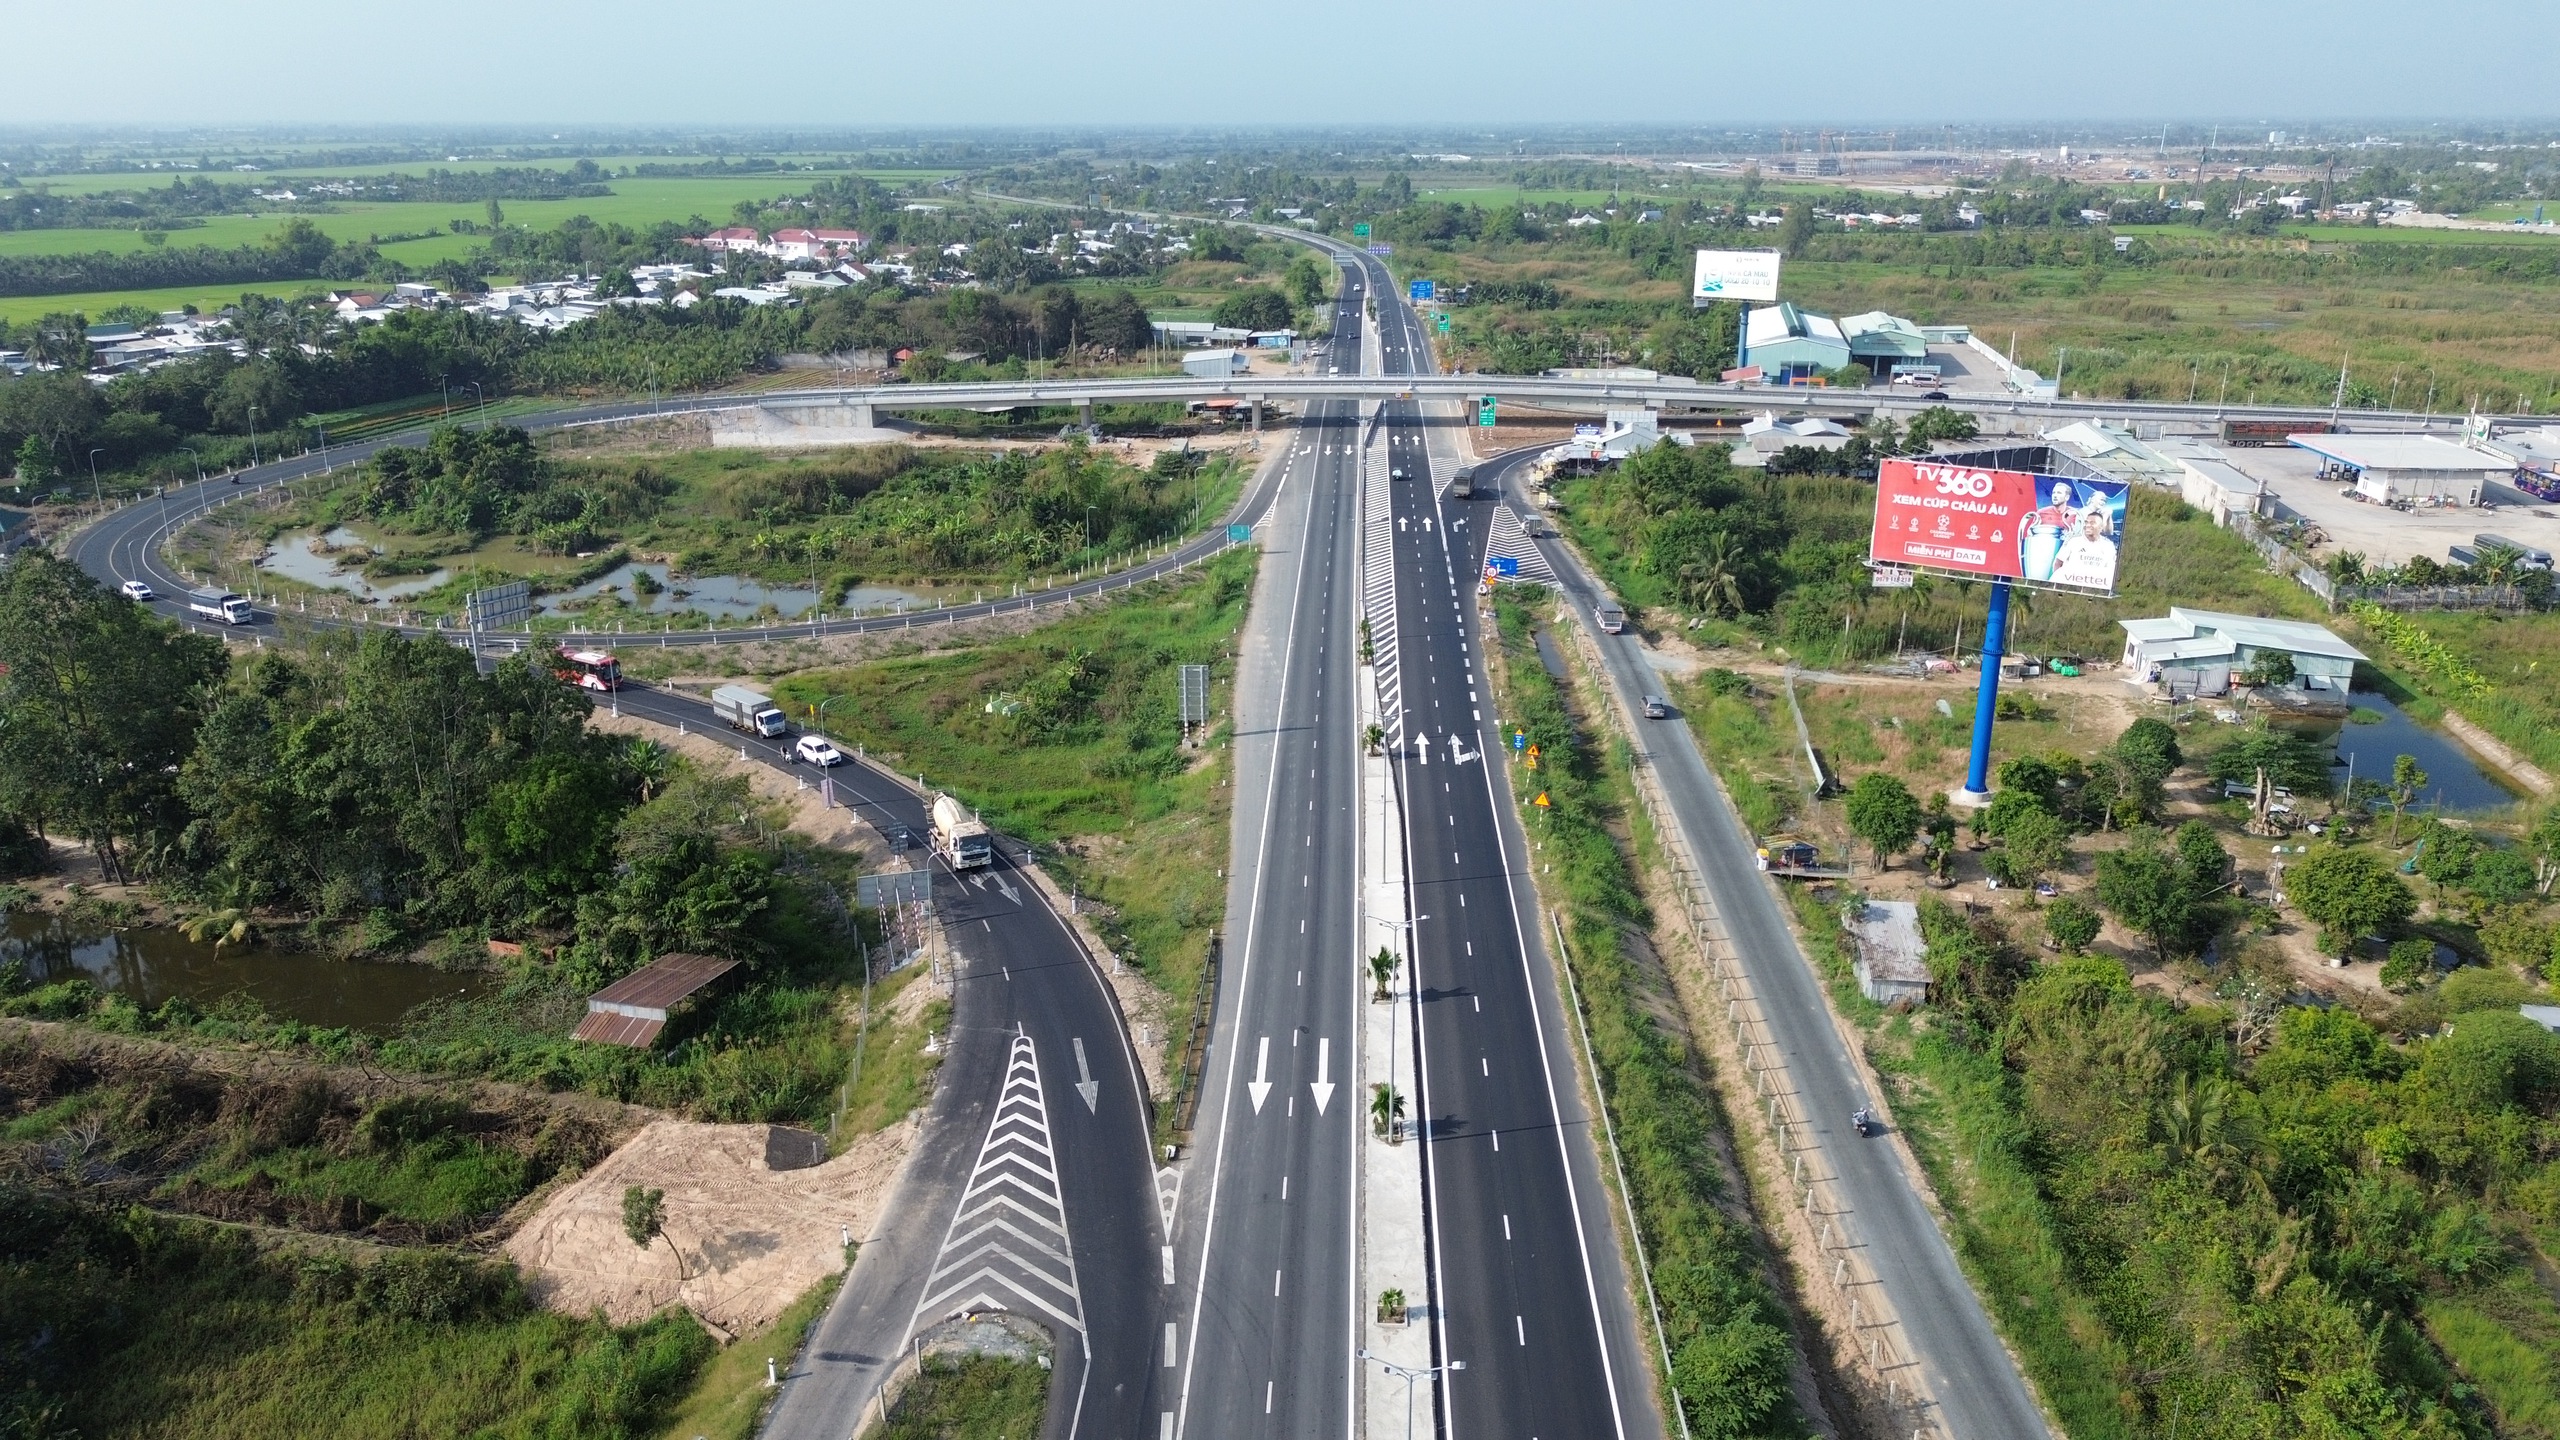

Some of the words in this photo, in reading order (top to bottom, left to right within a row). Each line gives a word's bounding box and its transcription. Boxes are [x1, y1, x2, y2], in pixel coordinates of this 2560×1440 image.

[1914, 466, 1993, 498] TV360
[1892, 494, 1922, 506] XEM
[1923, 497, 1950, 509] CÚP
[1950, 501, 1987, 513] CHÂU
[1987, 503, 2008, 516] ÂU
[1934, 549, 1953, 559] PHÍ
[1956, 551, 1981, 560] DATA
[2064, 574, 2108, 586] viettel
